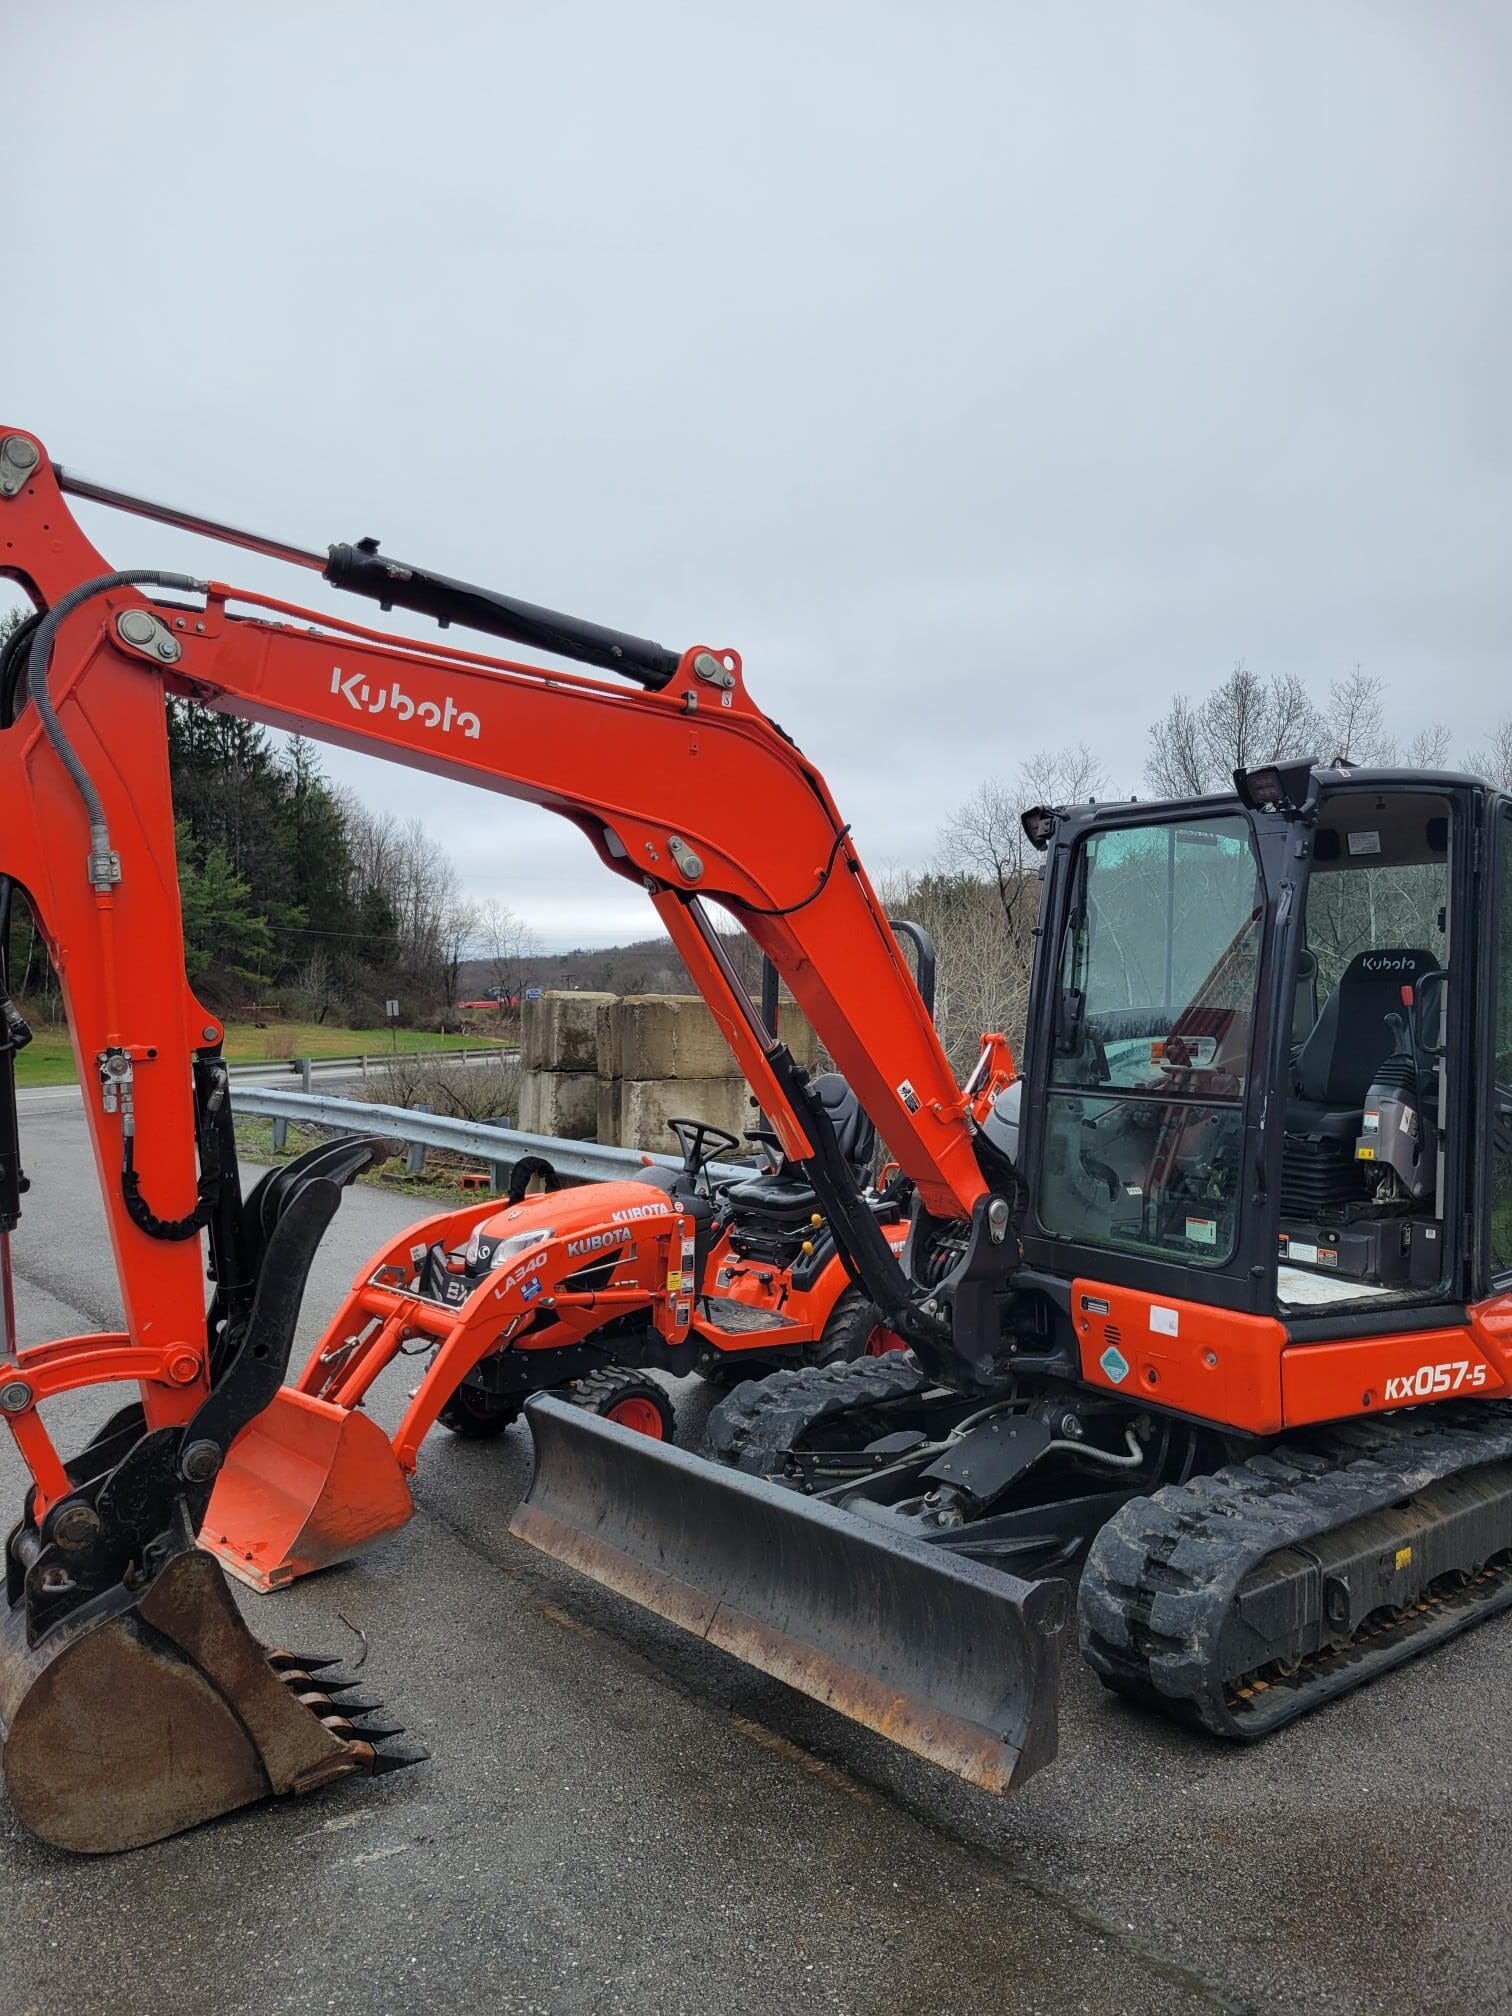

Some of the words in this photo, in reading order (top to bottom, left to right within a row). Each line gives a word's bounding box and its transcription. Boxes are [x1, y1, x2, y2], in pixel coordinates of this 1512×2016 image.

[330, 667, 481, 739] Kubota
[1362, 957, 1416, 970] Kubota
[611, 1203, 669, 1222] KUBOTA
[568, 1227, 633, 1257] KUBOTA
[494, 1252, 548, 1300] LA340
[1383, 1361, 1486, 1401] KX057-5
